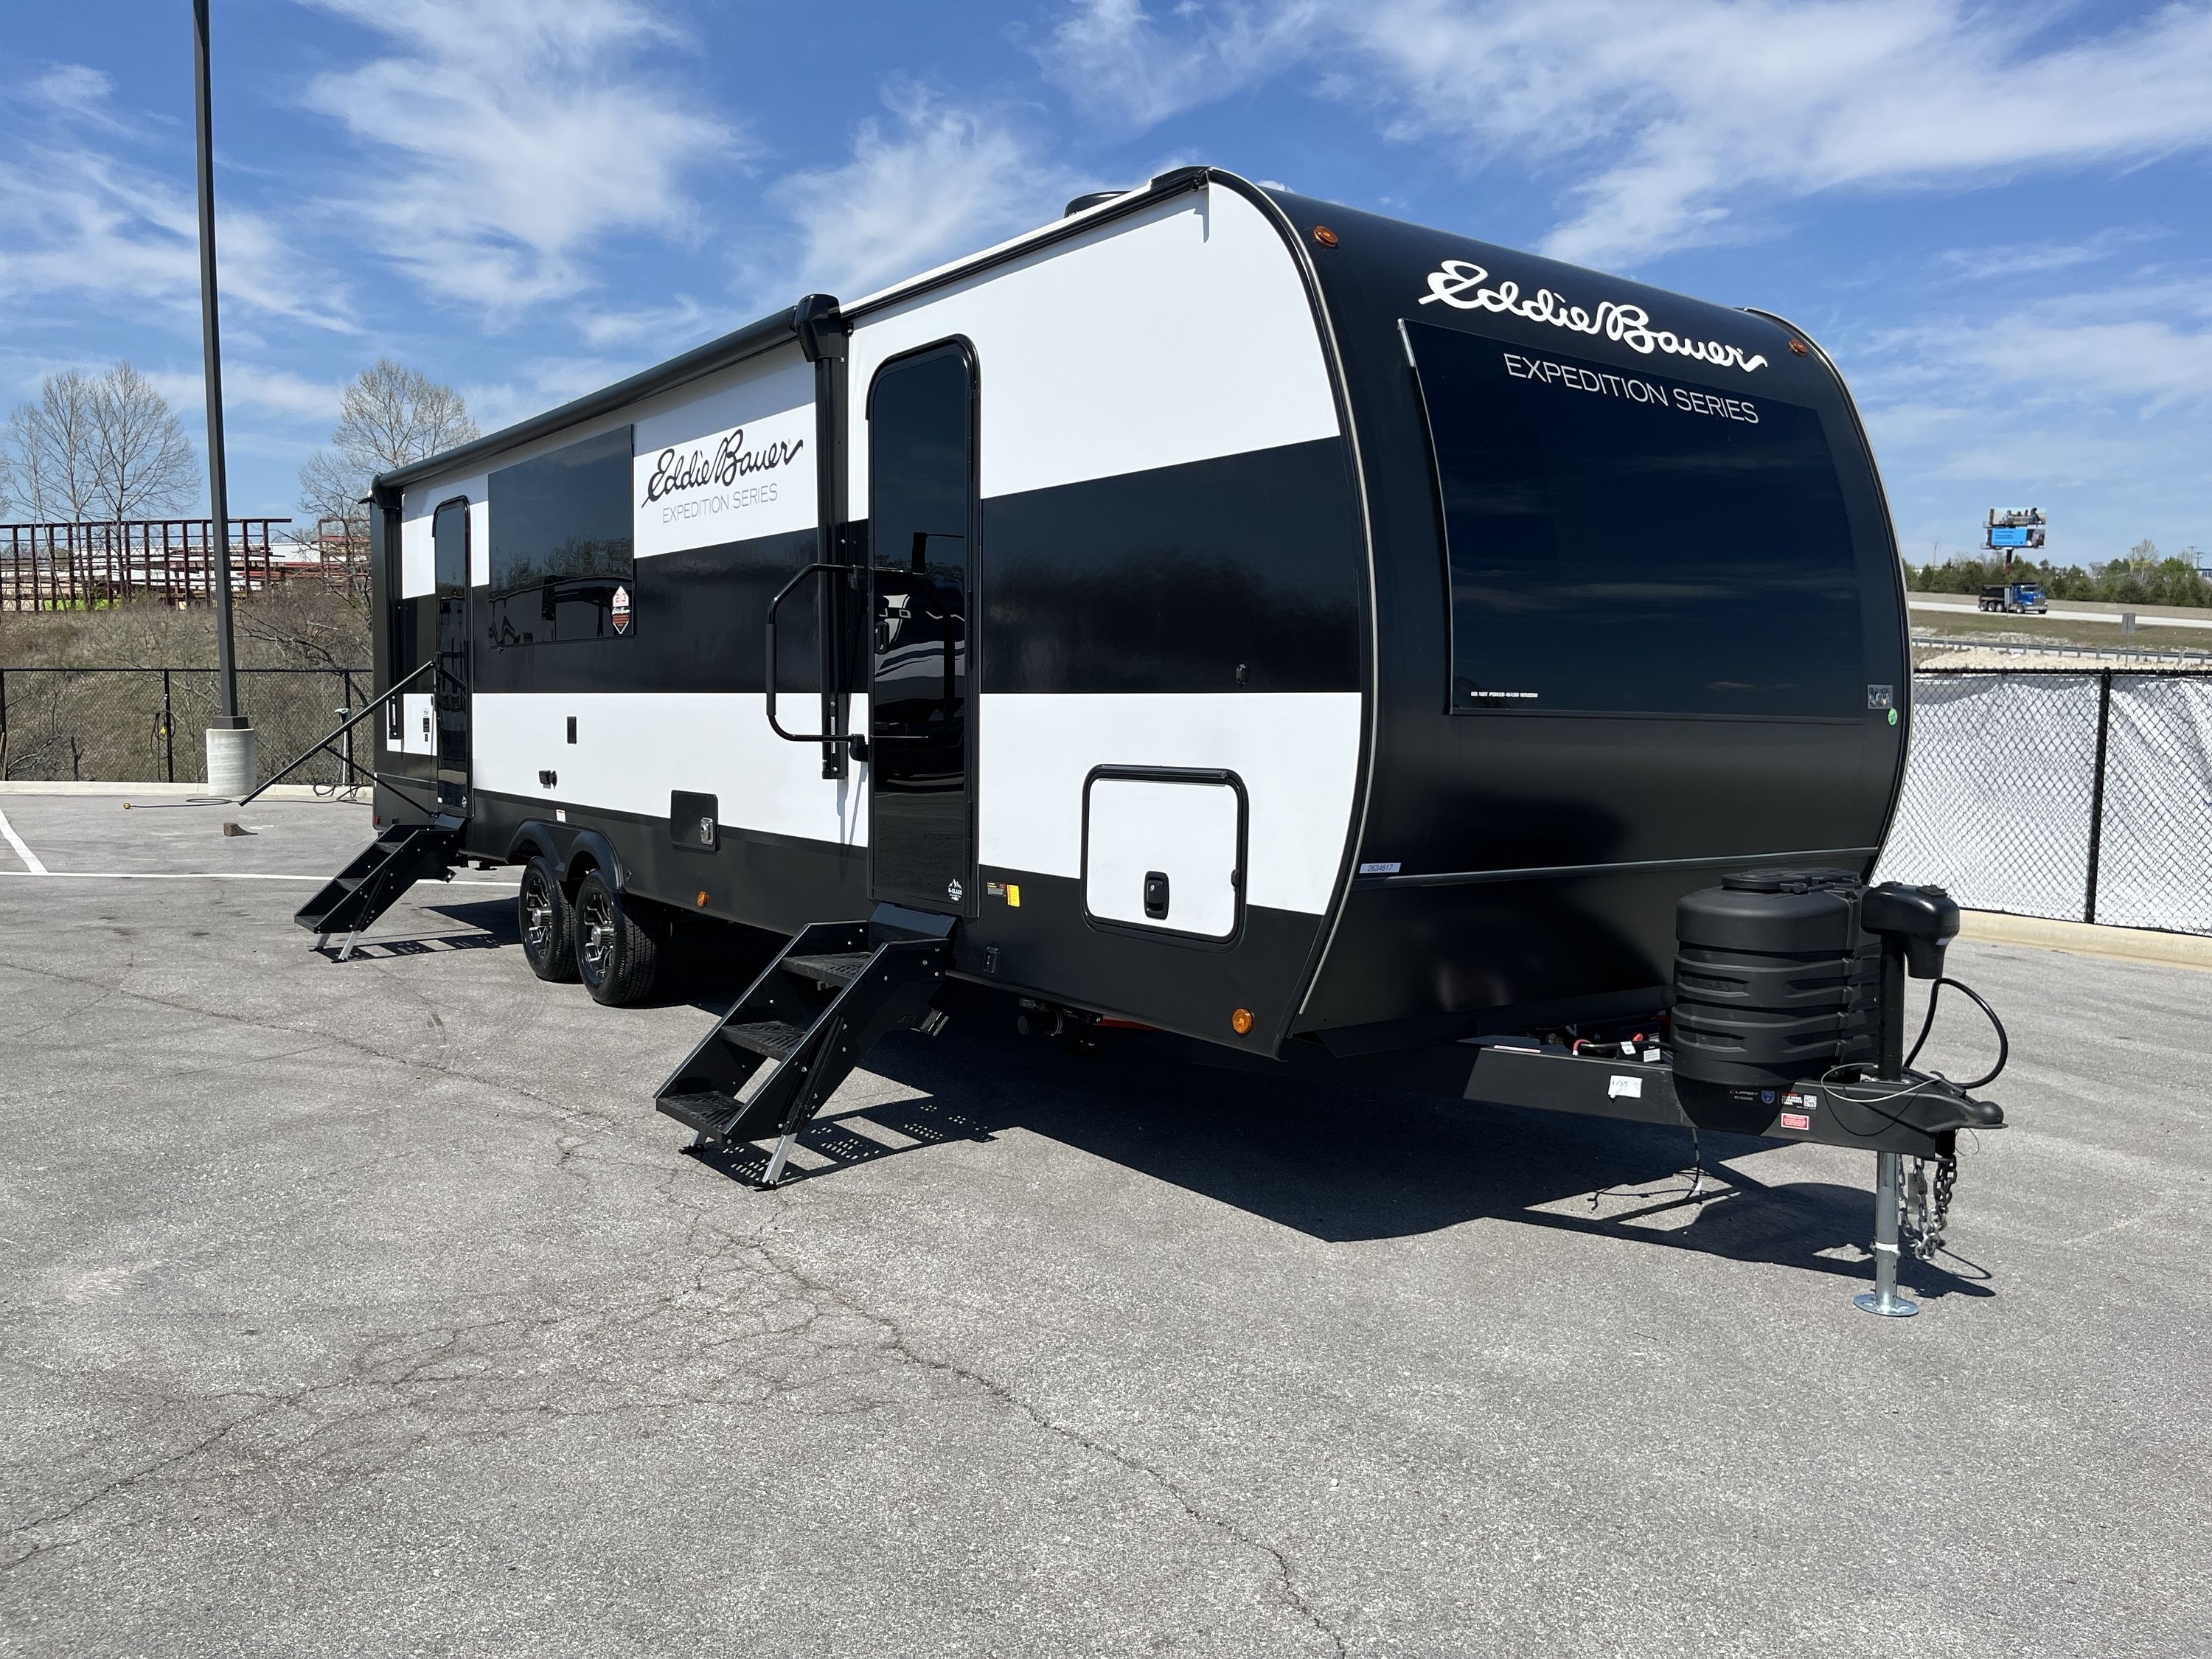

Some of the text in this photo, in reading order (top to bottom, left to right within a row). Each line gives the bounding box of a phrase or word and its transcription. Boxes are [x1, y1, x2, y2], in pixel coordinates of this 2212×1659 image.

[1419, 260, 1769, 372] Eddie Bauer
[1503, 353, 1759, 424] EXPEDITION SERIES
[641, 428, 804, 509] Eddie Bauer
[662, 483, 778, 524] EXPEDITION SERIES
[1367, 864, 1394, 872] 2634617
